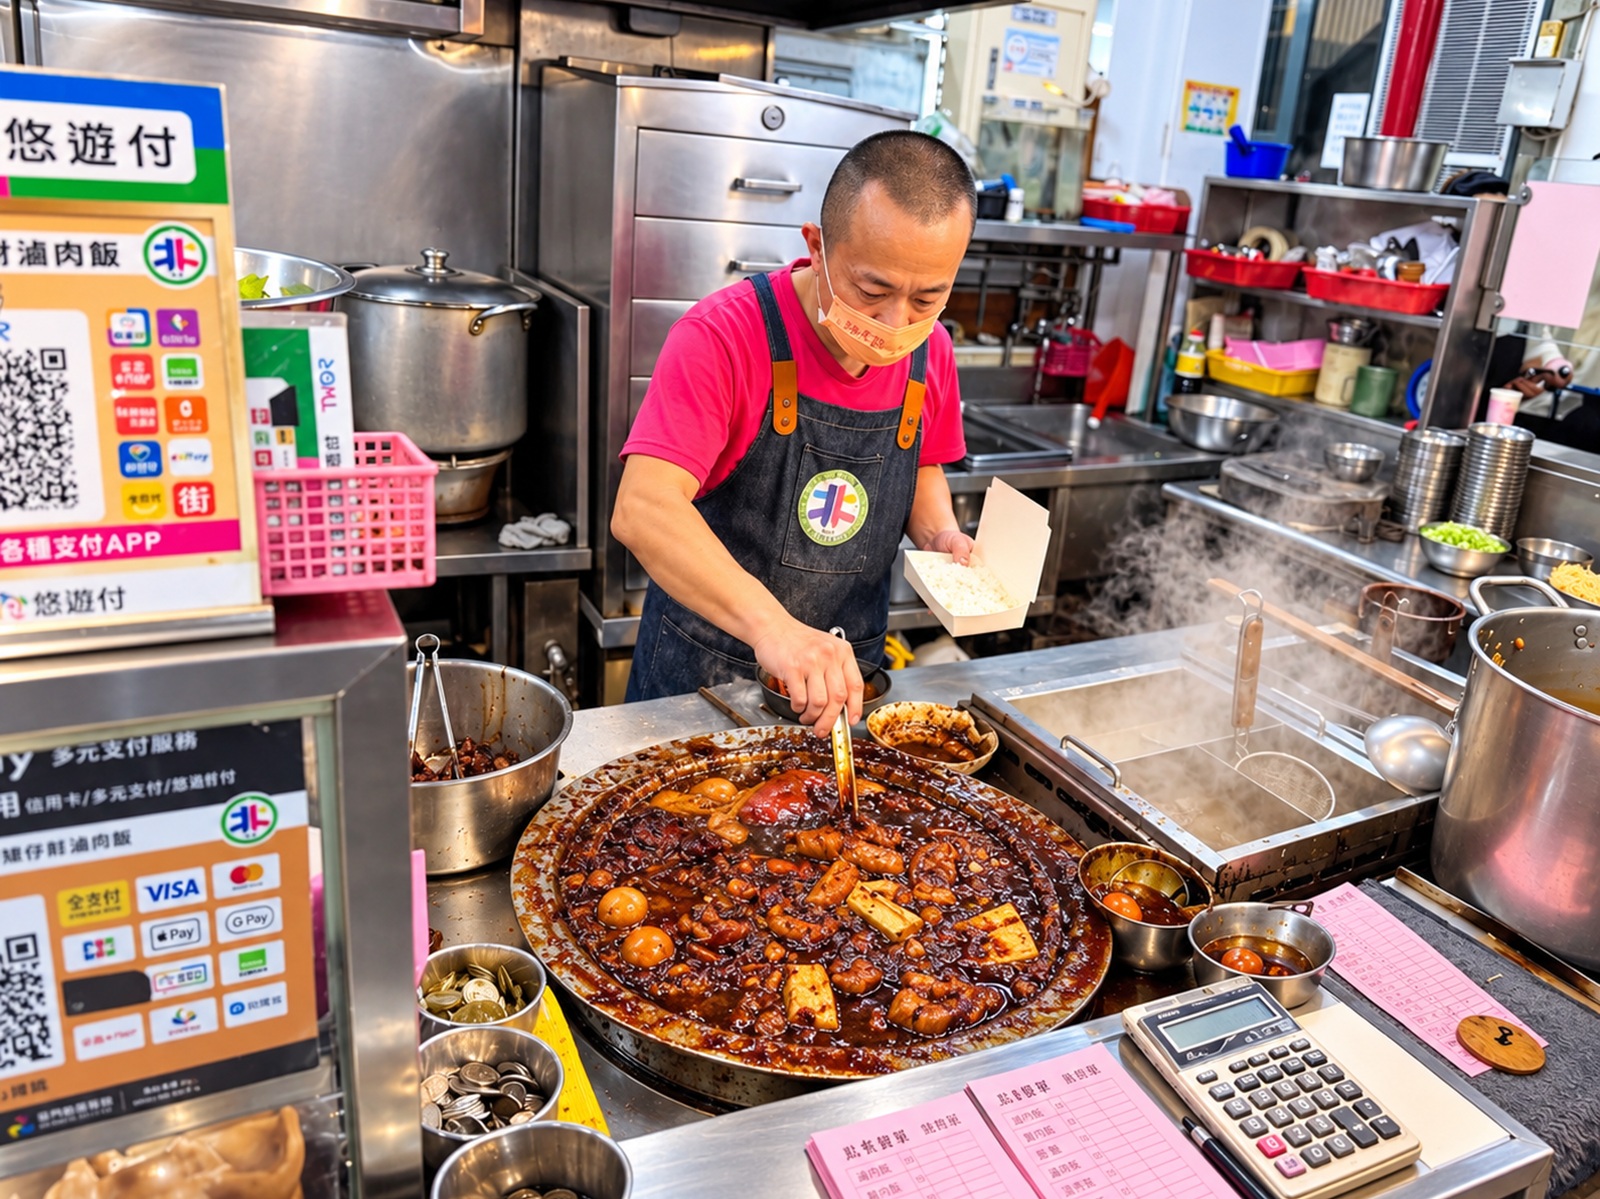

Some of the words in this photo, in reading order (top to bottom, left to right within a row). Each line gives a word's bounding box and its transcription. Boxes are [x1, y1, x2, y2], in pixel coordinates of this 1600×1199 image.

[4, 117, 176, 168] 悠遊付
[178, 486, 211, 514] 街
[0, 531, 162, 563] 各種支付APP
[33, 586, 126, 617] 悠遊付
[51, 731, 199, 768] 多元支付服務
[143, 879, 200, 902] VISA
[169, 927, 195, 940] Pay
[245, 912, 268, 929] Pay
